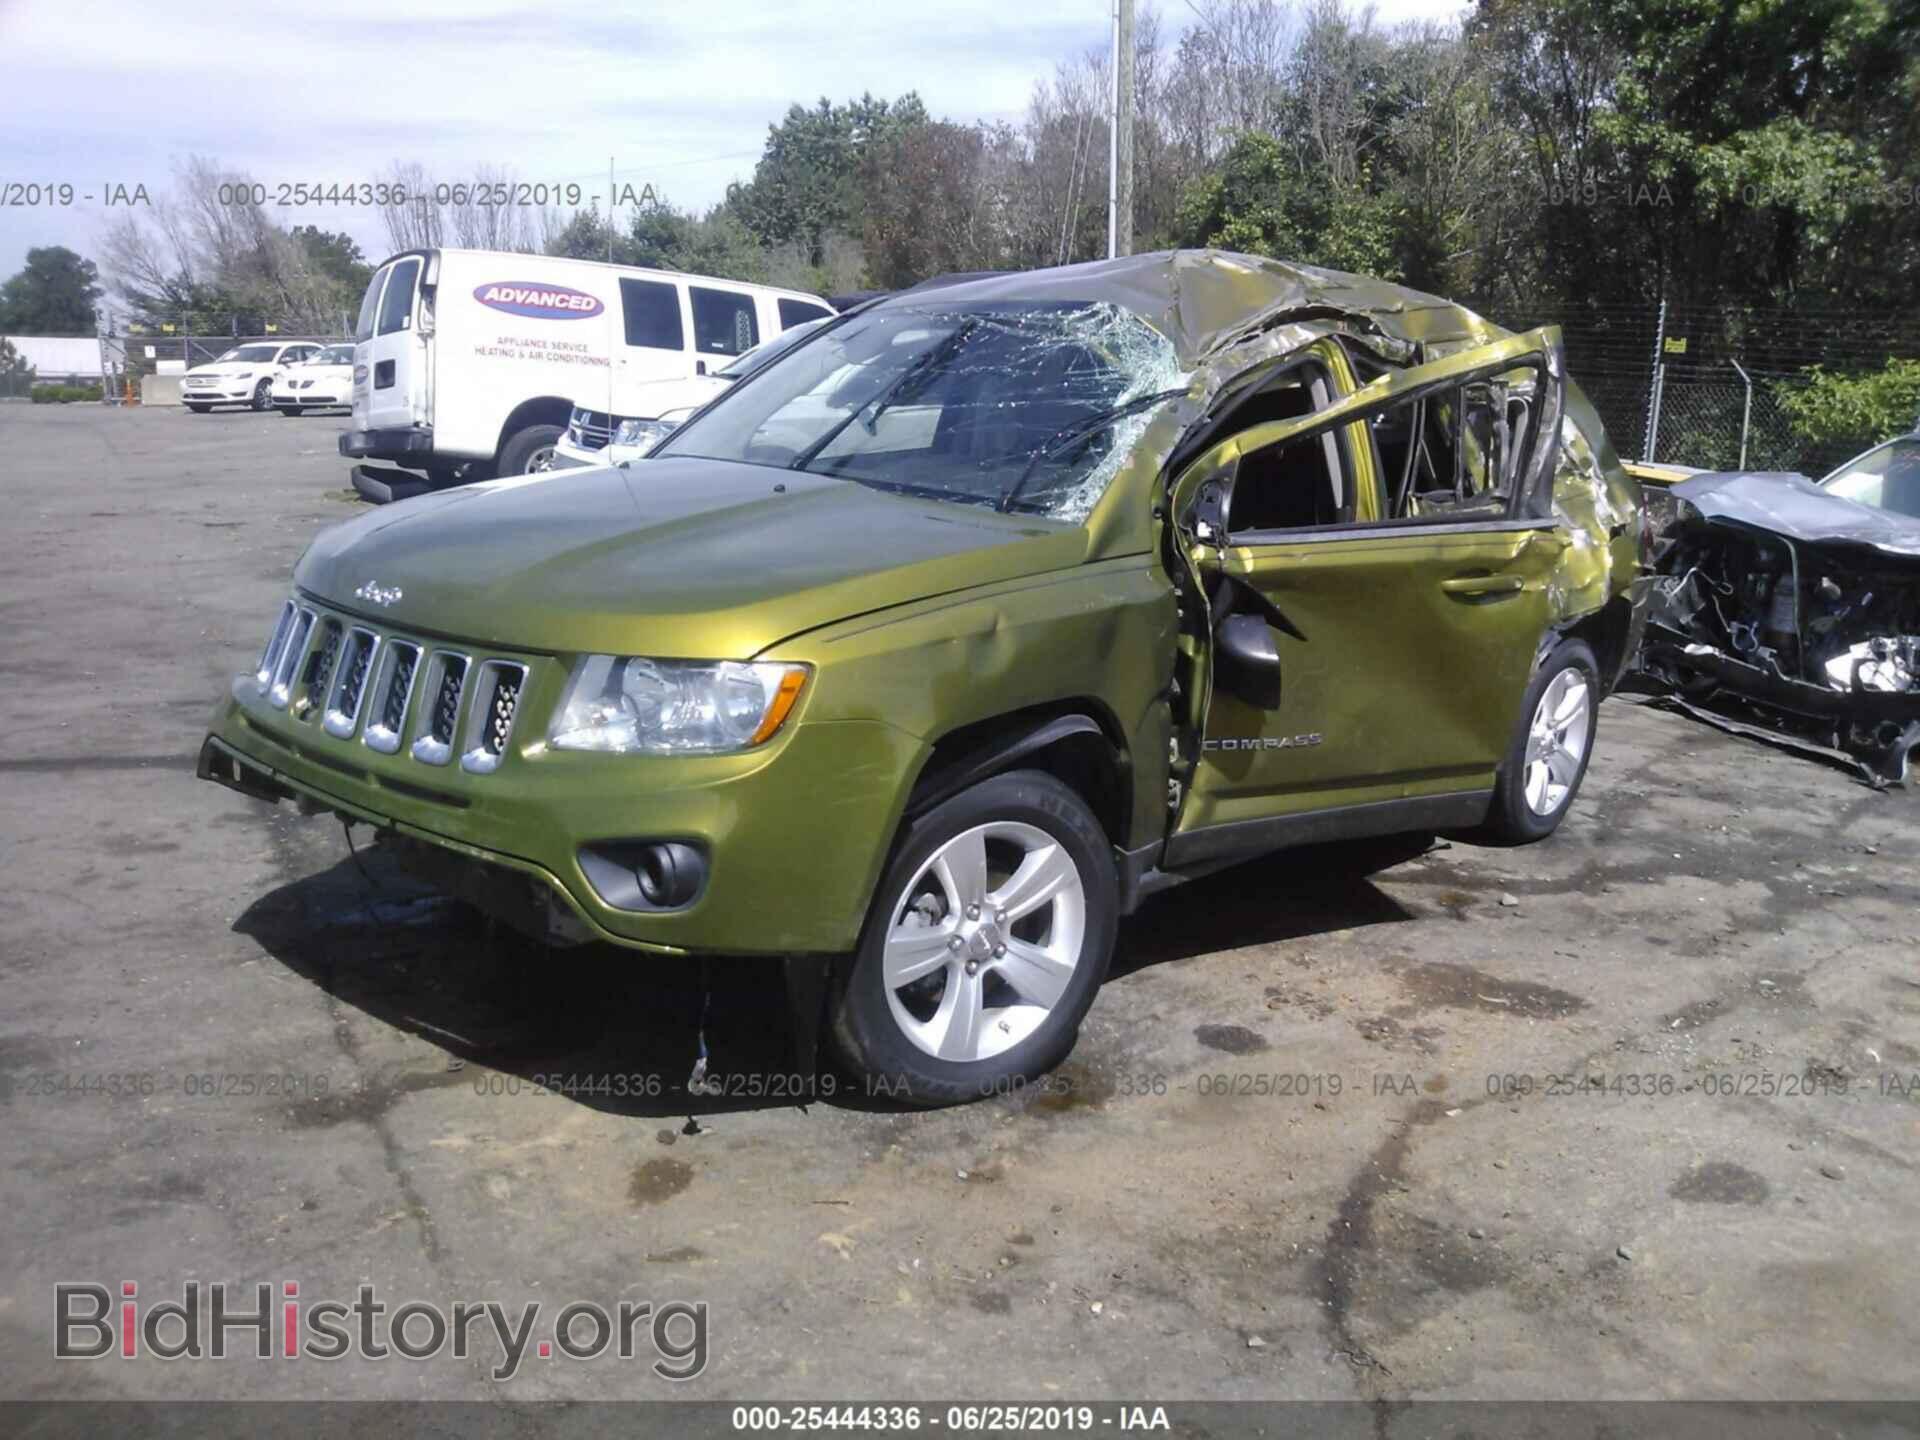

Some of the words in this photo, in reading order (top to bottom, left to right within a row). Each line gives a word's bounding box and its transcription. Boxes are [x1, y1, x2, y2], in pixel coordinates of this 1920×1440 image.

[484, 287, 598, 311] ADVANCED
[497, 336, 547, 350] APPLIANCE
[551, 340, 589, 353] SERVICE
[475, 347, 515, 360] HEATING
[528, 353, 544, 362] AIR
[546, 354, 611, 368] CONDITIONING
[1201, 733, 1321, 751] COMPASS
